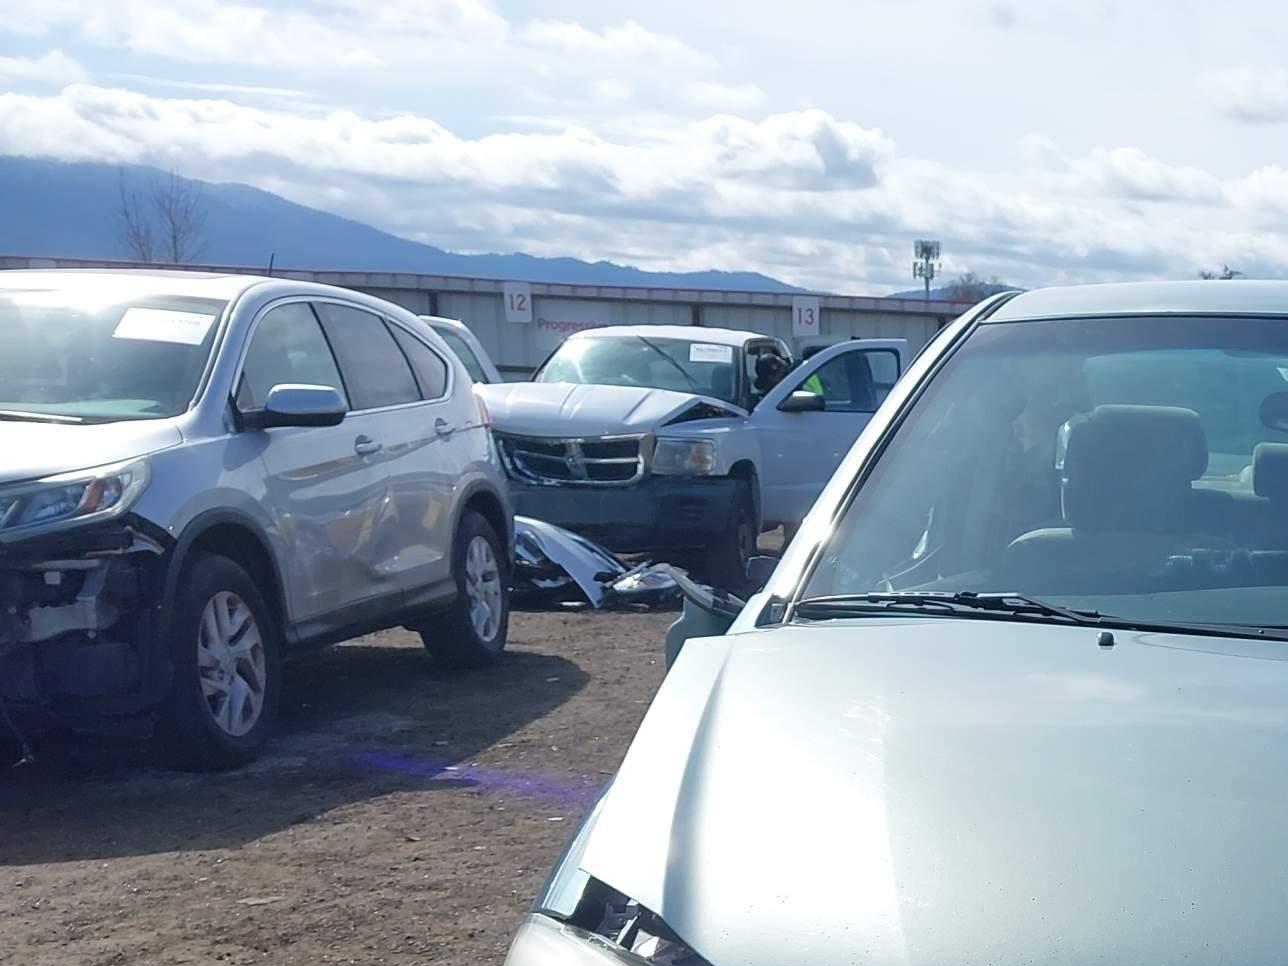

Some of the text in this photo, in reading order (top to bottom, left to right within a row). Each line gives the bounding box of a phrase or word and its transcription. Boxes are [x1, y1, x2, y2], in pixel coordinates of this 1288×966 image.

[509, 293, 527, 311] 12
[537, 317, 607, 333] Progress
[798, 307, 815, 326] 13
